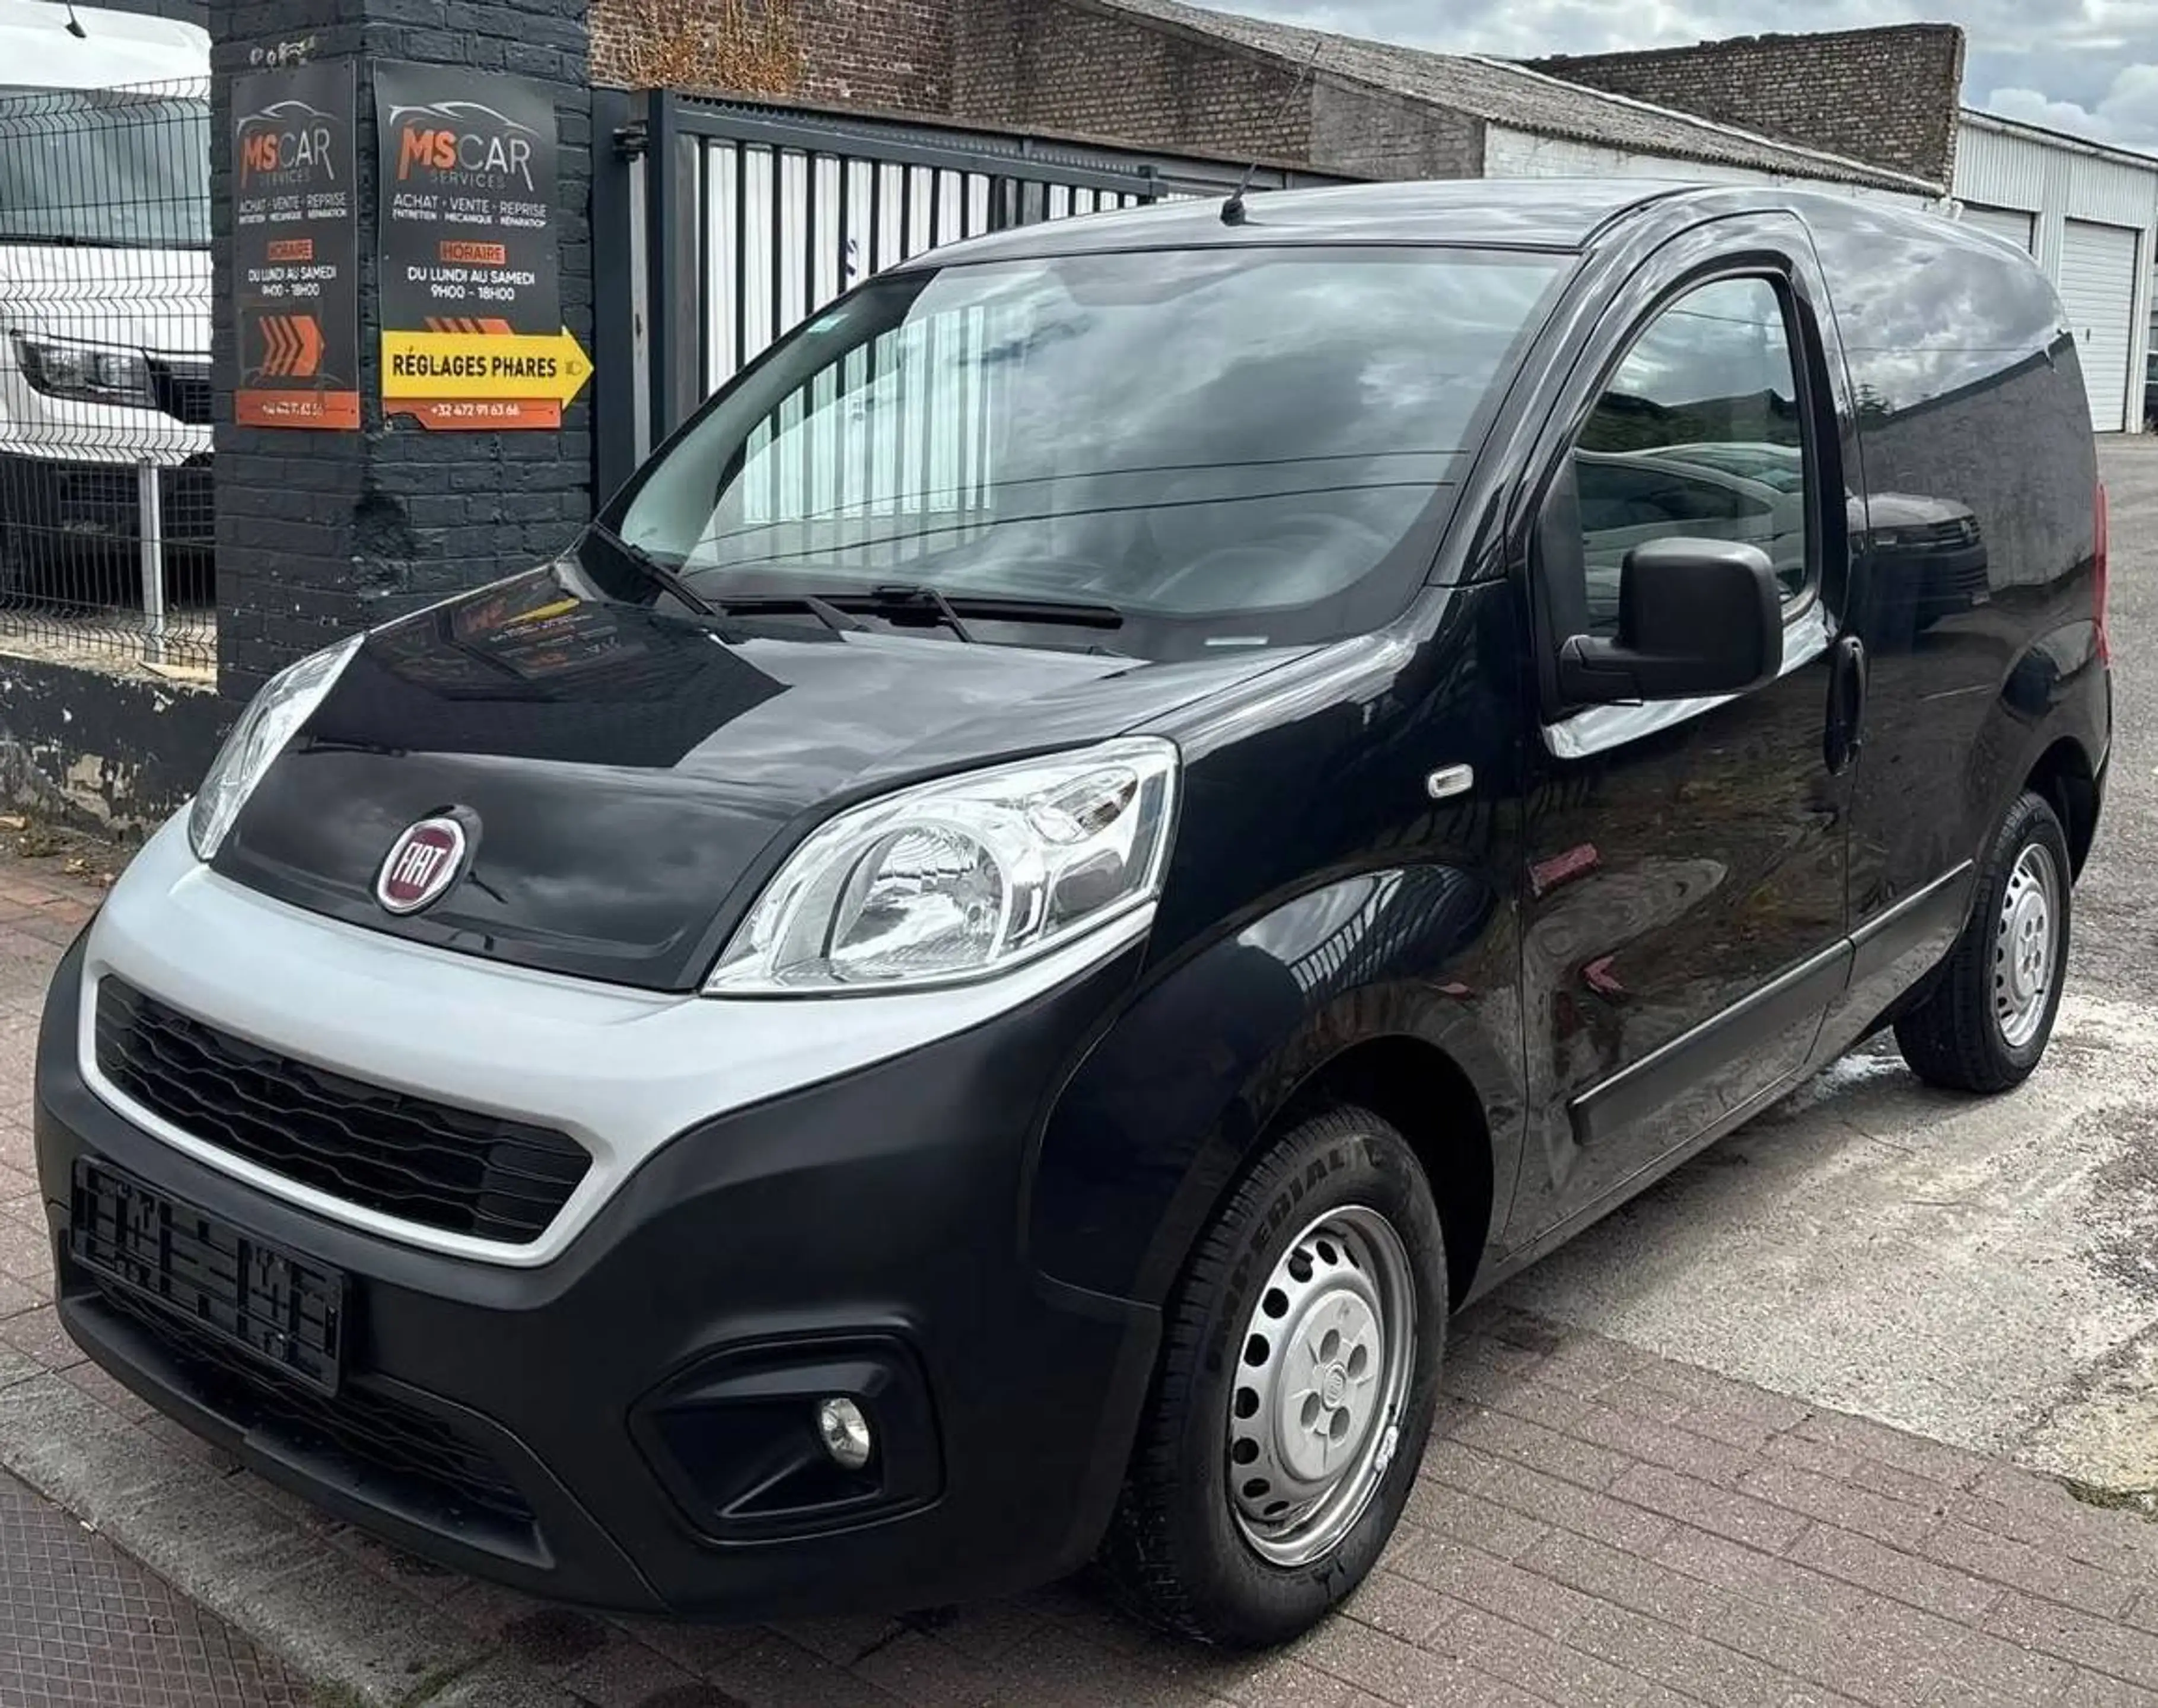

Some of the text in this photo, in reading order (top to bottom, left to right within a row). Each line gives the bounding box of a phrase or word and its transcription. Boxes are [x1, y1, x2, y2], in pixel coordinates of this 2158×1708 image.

[397, 126, 534, 192] MSCAR
[393, 194, 546, 218] ACHAT VENTE REPRISE
[444, 244, 503, 261] HORAIRE
[408, 266, 535, 285] DU LUNDI AU SAMEDI
[431, 284, 466, 299] 9H00
[478, 286, 515, 301] 18H00
[393, 345, 557, 378] RÉGLAGES PHARES
[392, 842, 447, 888] FIAT
